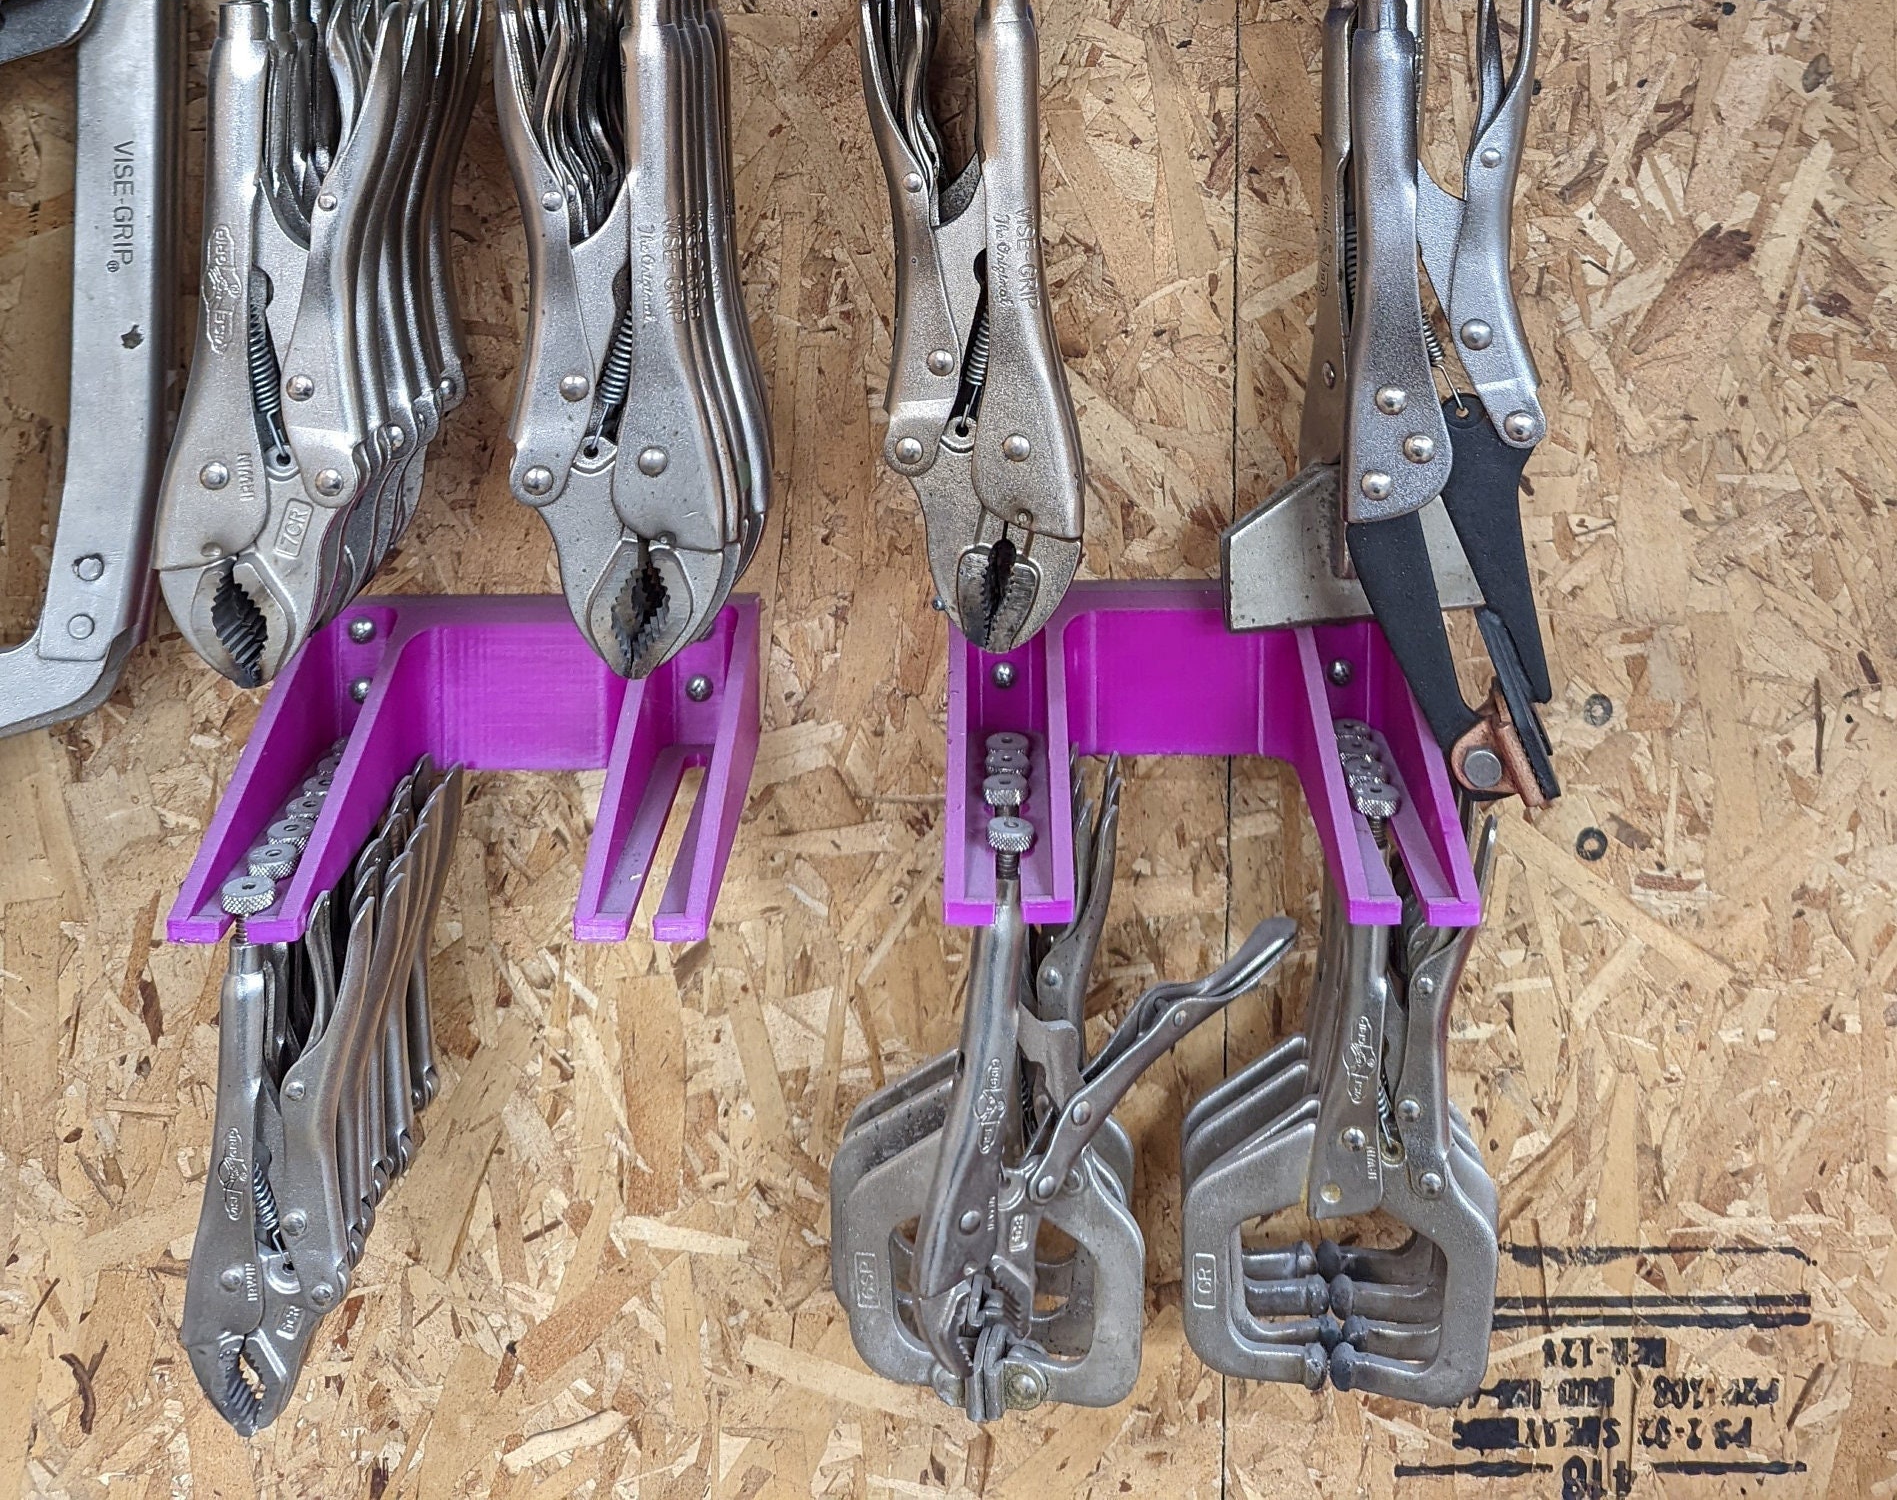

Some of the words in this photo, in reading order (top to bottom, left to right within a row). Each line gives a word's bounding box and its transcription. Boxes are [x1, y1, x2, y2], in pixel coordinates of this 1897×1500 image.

[112, 140, 135, 266] VISE-GRIP
[662, 214, 686, 324] VISE-GRIP
[992, 241, 1014, 307] Original
[1015, 207, 1040, 309] VISE-GRIP
[237, 453, 255, 501] IRWIN
[245, 1263, 258, 1302] IRWIN
